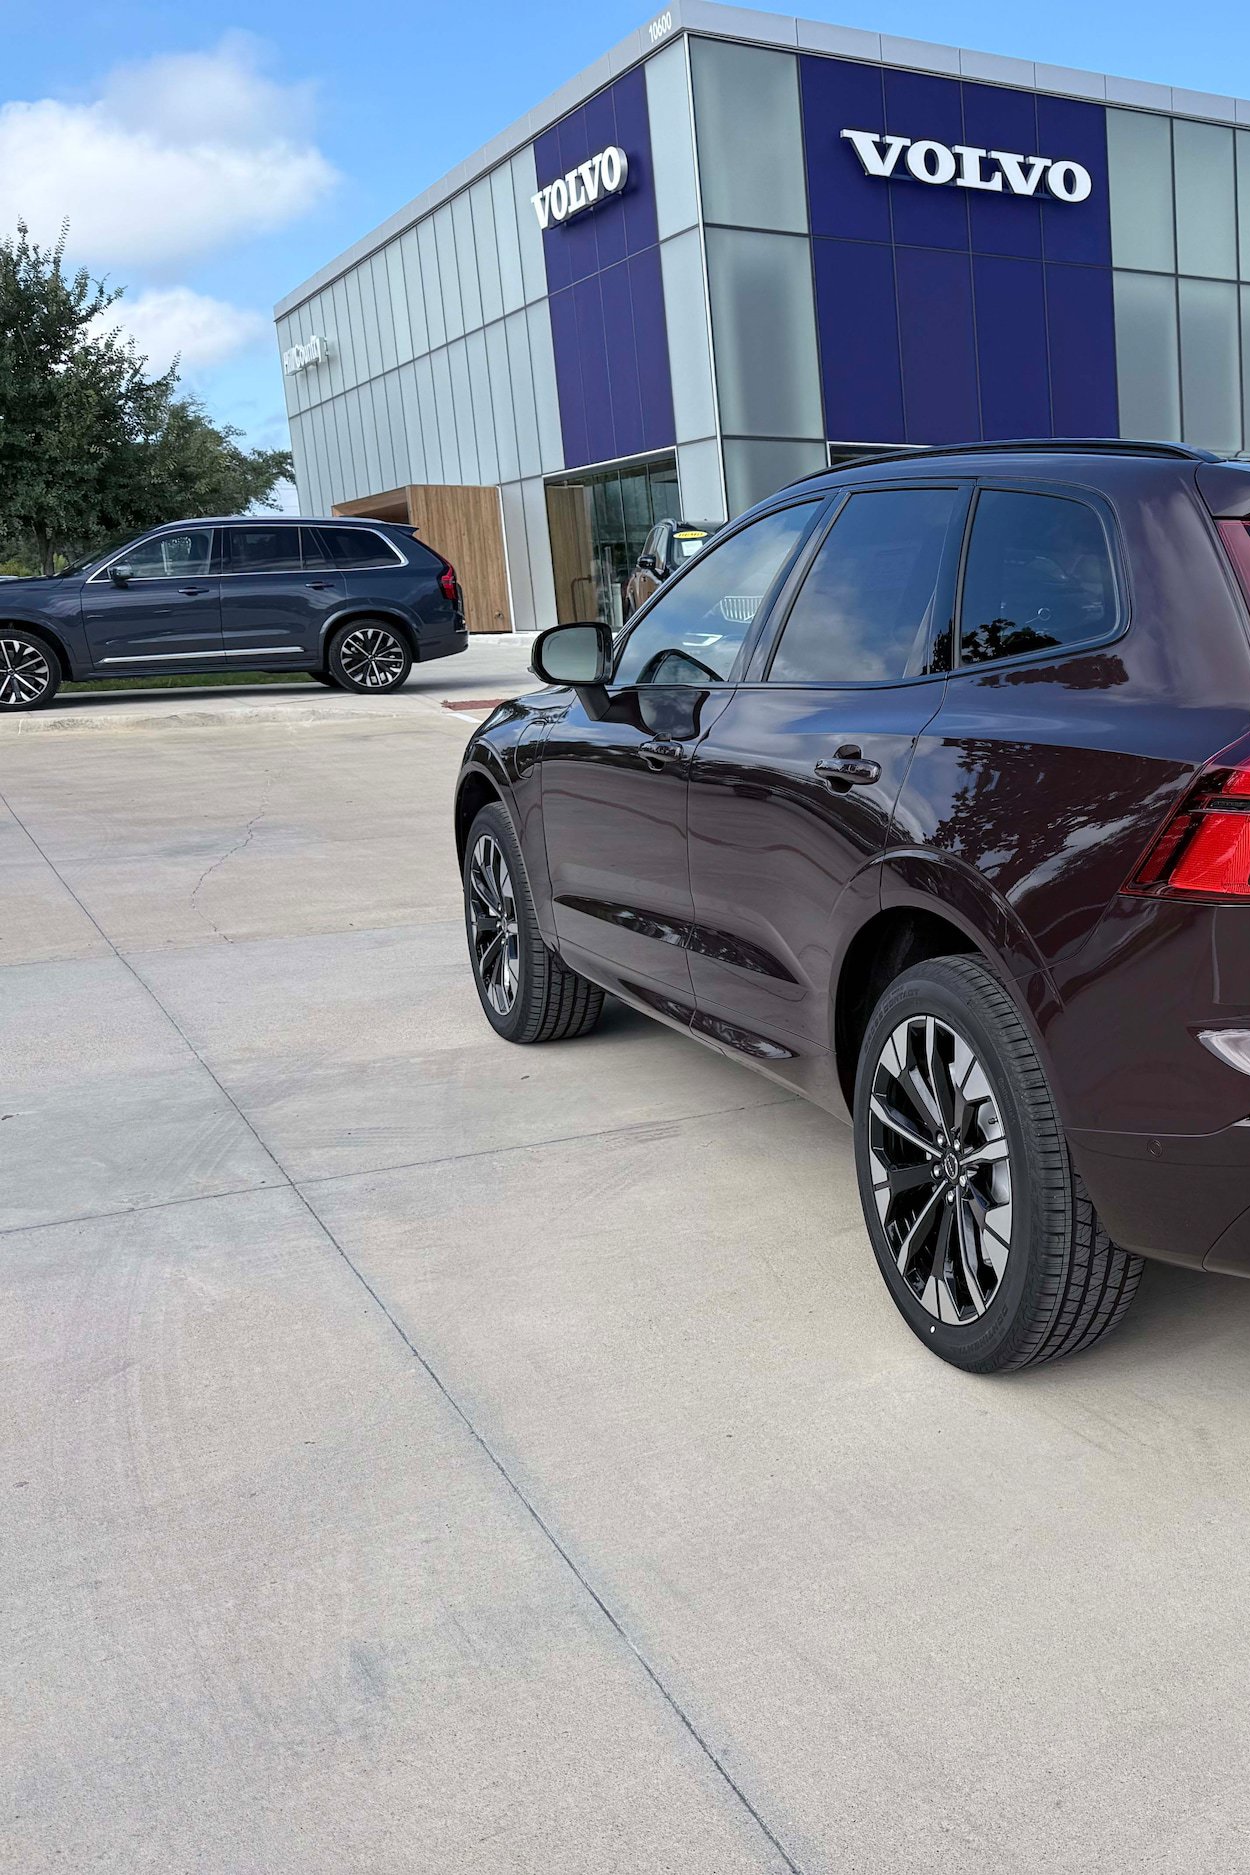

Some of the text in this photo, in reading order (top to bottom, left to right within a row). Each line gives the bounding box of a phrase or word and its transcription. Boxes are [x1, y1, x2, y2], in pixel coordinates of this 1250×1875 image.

[649, 11, 672, 42] 10600
[530, 146, 628, 229] VOLVO
[840, 129, 1092, 203] VOLVO
